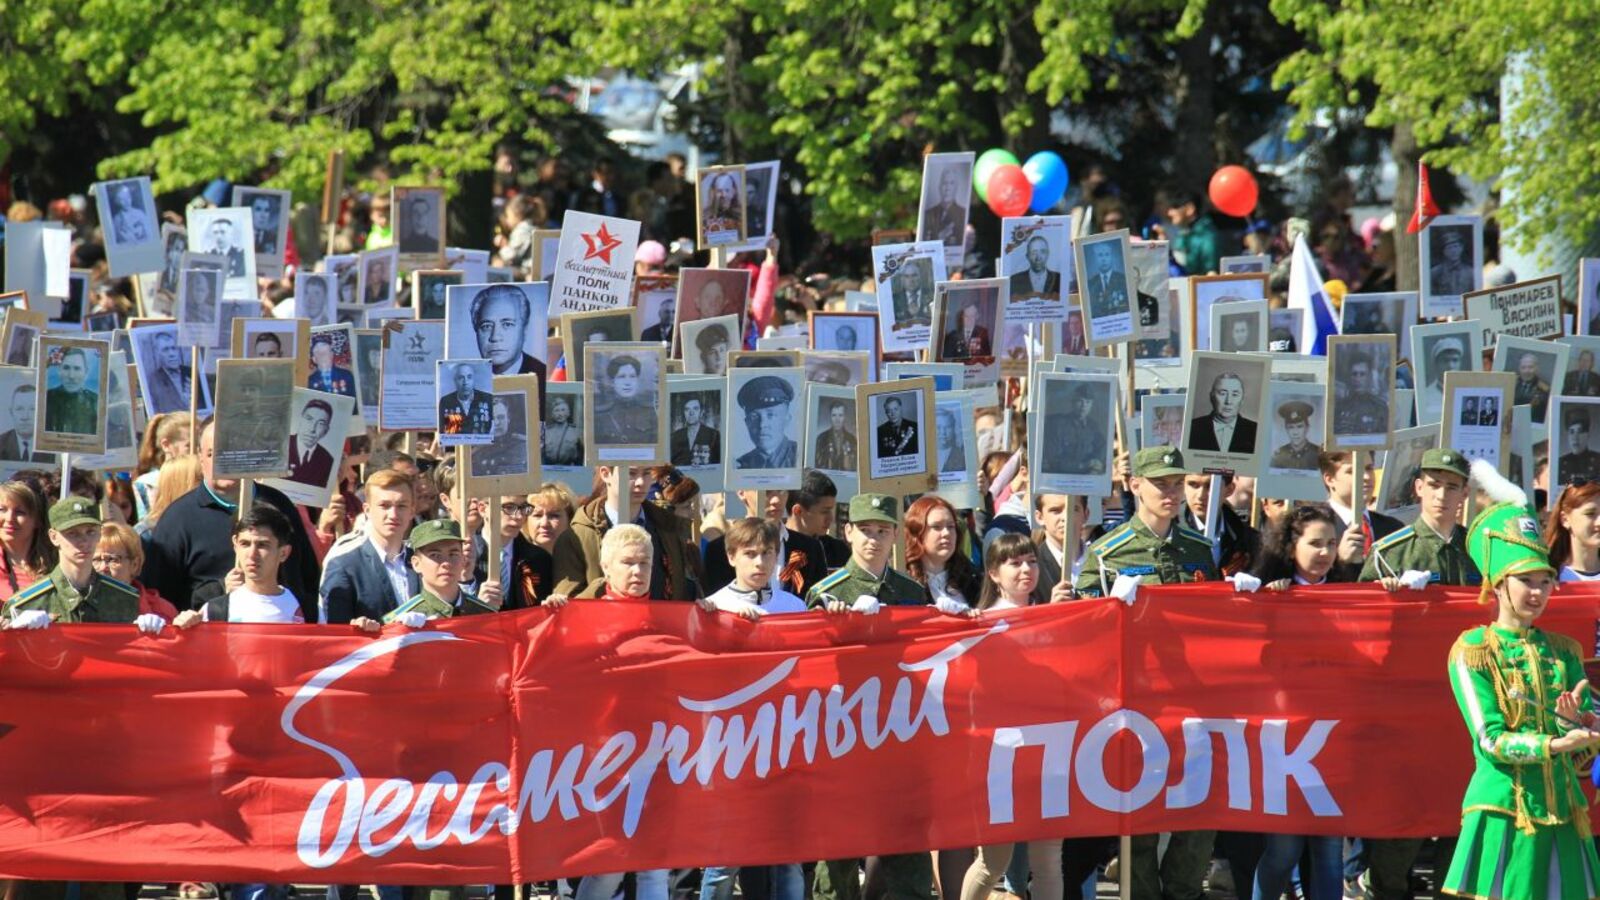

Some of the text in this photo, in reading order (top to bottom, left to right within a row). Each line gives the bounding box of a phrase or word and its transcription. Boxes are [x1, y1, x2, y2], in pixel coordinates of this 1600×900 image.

[564, 259, 627, 281] бессмертный
[577, 275, 610, 290] ПОЛК
[560, 299, 612, 311] АНДР
[562, 286, 618, 305] ПАНКОВ
[988, 709, 1344, 825] ПОЛК
